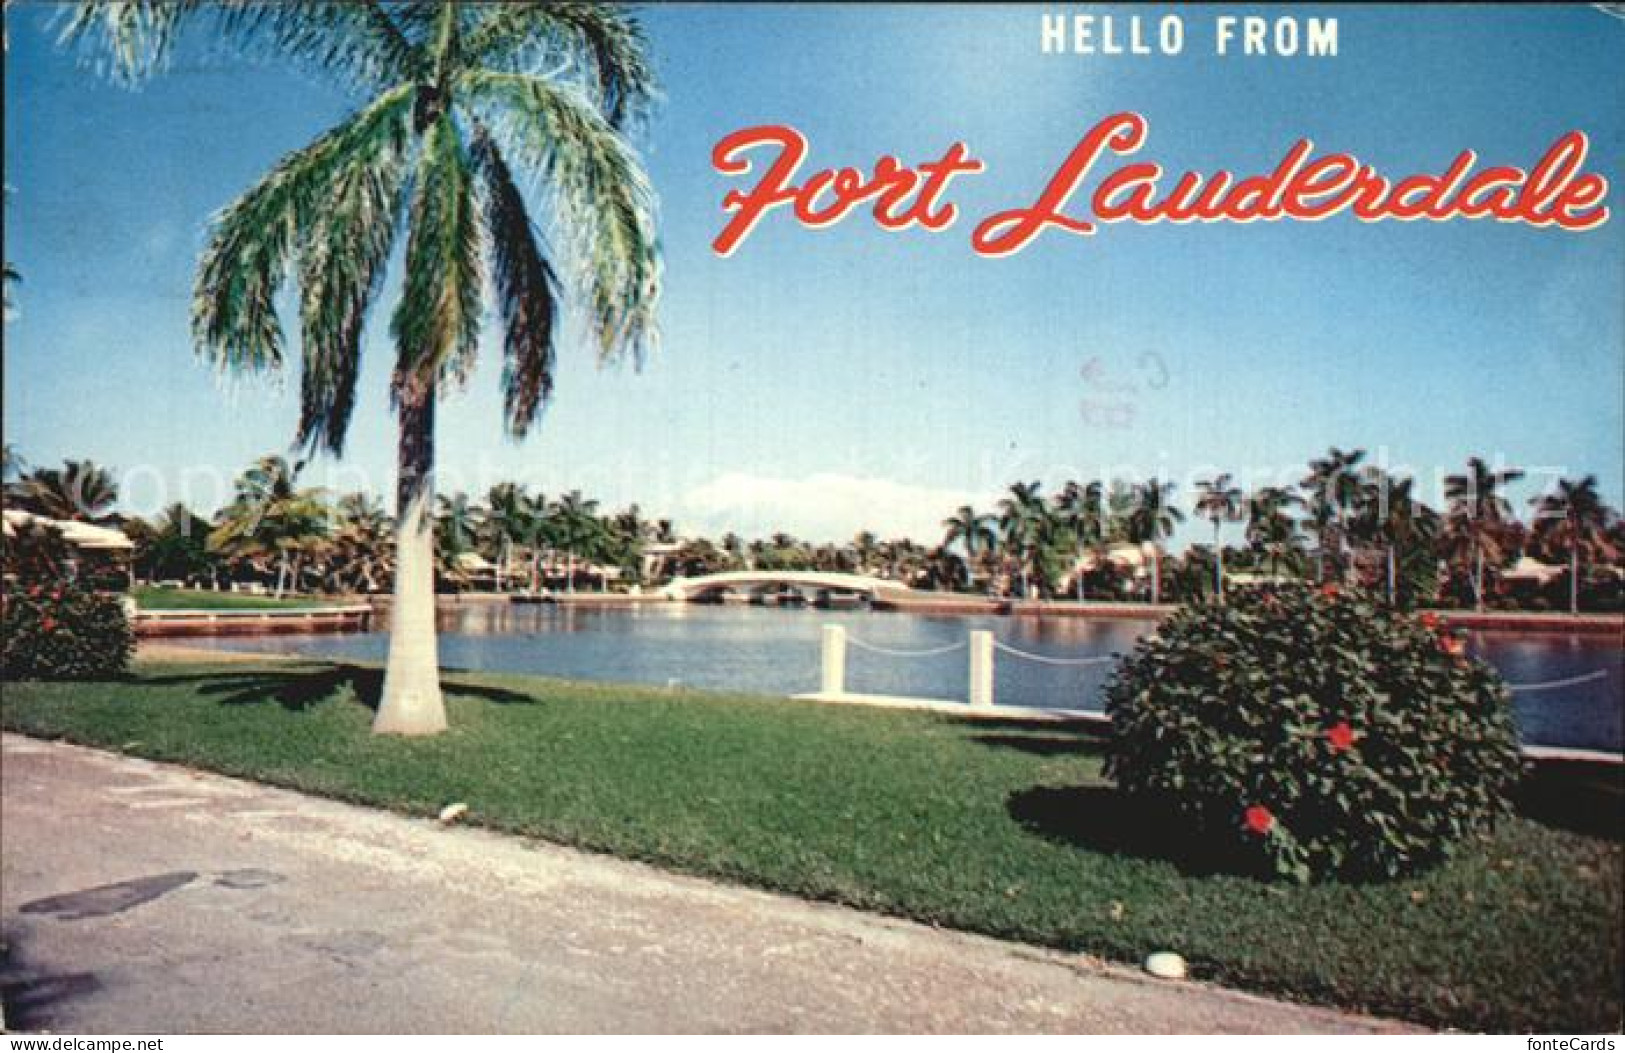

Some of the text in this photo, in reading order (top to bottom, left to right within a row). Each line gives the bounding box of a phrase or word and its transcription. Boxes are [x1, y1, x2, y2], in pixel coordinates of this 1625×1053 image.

[1041, 14, 1339, 56] HELLO FROM
[711, 111, 1610, 257] Fort Lauderdale
